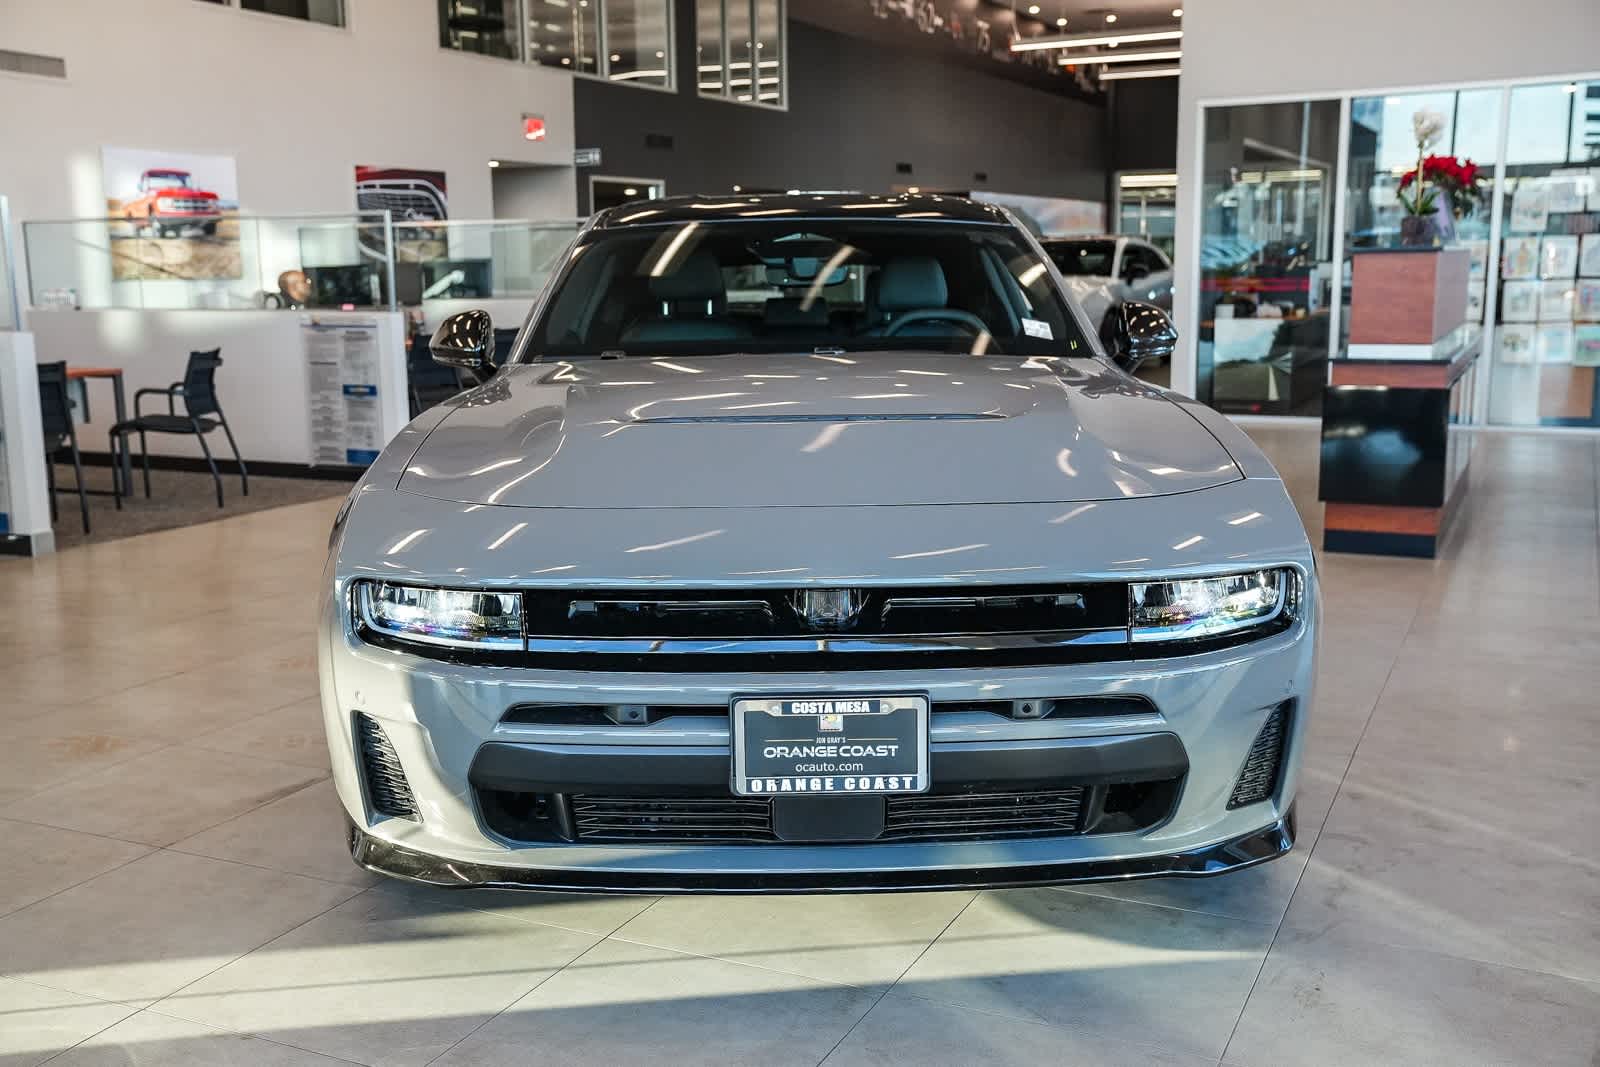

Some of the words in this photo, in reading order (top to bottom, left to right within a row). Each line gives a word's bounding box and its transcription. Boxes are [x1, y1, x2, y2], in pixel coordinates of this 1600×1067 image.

[791, 701, 833, 714] COSTA
[835, 701, 871, 713] MESA
[795, 762, 864, 773] ocauto.com
[751, 779, 834, 792] ORANGE
[844, 777, 913, 790] COAST
